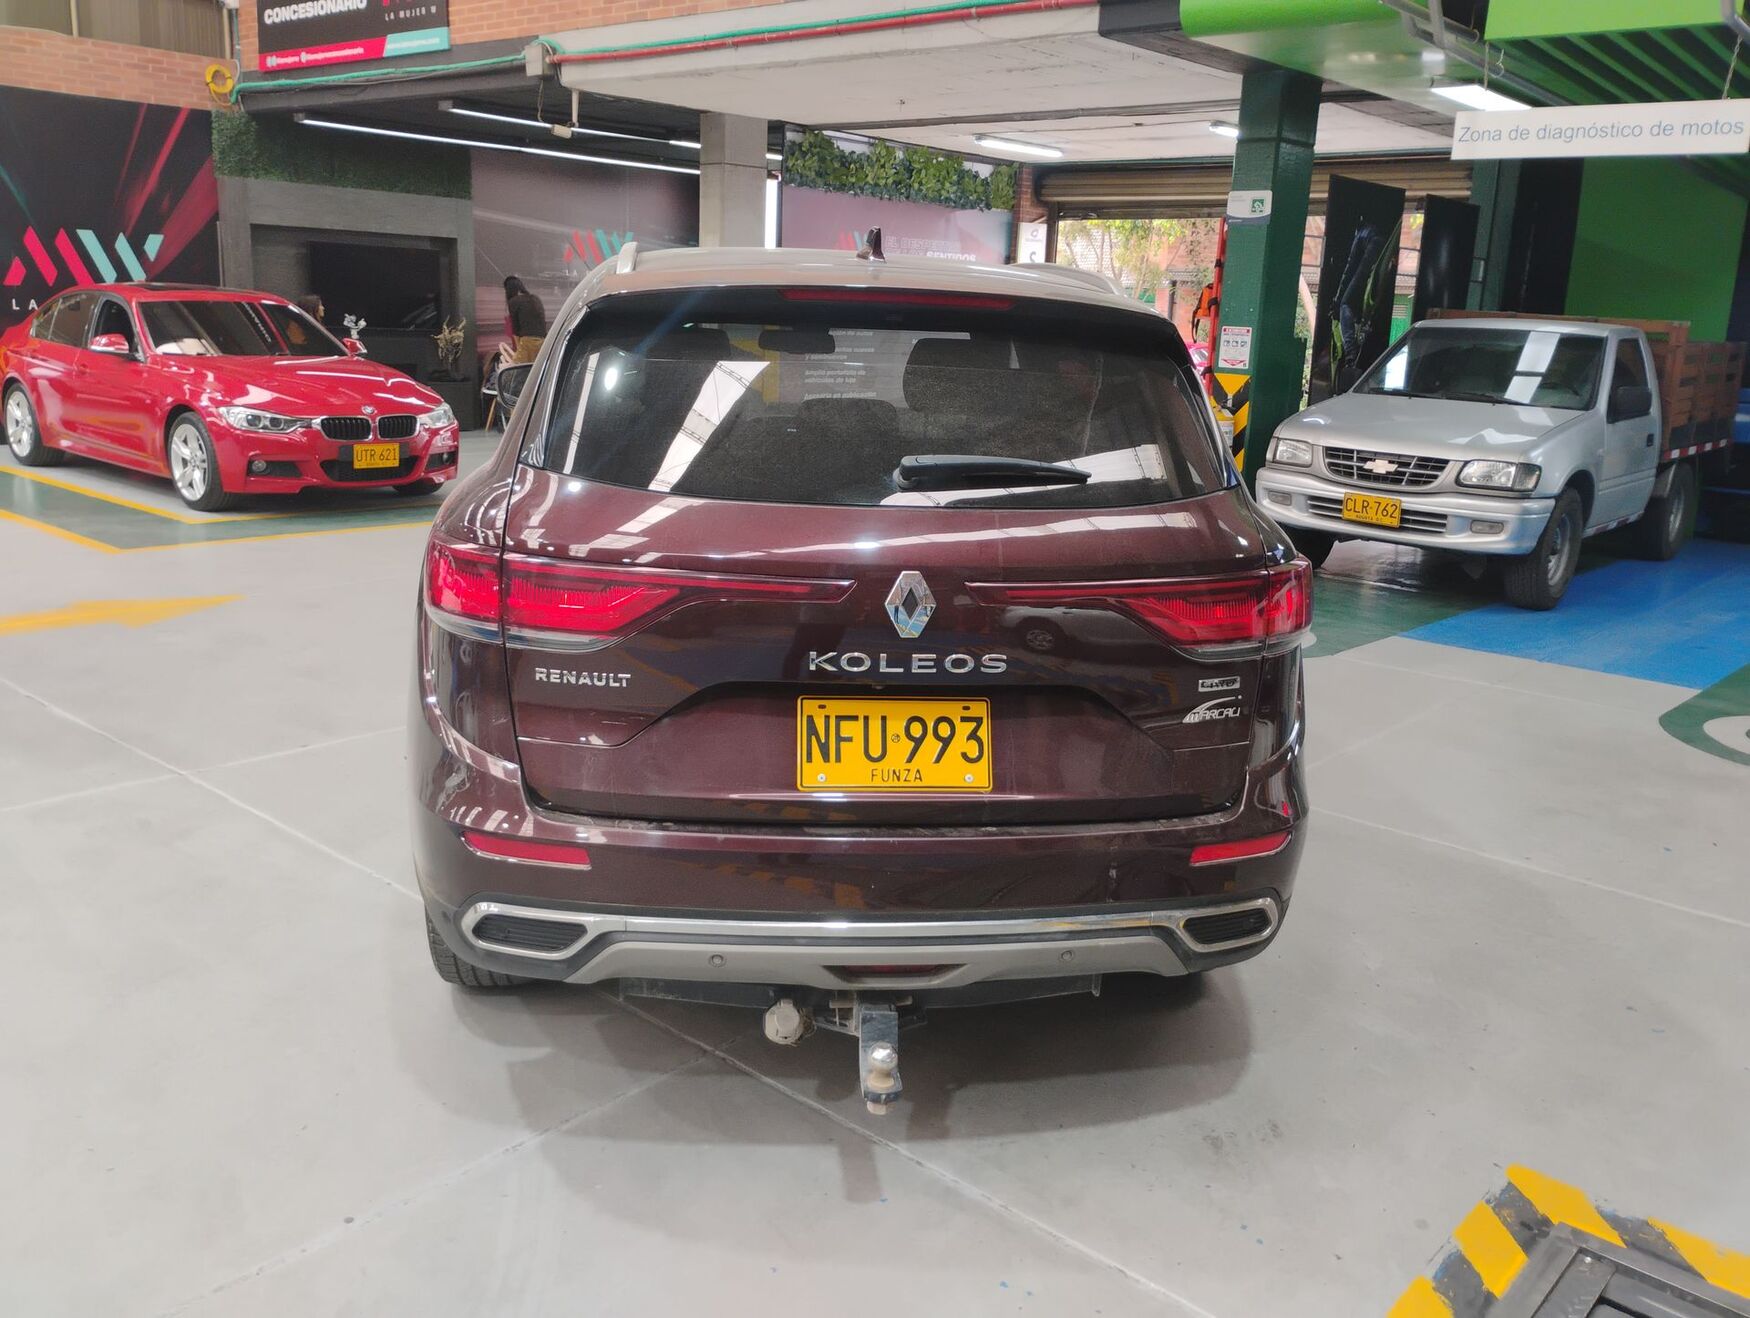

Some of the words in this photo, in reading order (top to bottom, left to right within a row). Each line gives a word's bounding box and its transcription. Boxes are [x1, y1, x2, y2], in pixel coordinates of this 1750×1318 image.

[264, 0, 368, 24] CONCESIONARIO
[1458, 126, 1501, 143] Zona
[1508, 125, 1530, 141] de
[1536, 121, 1643, 143] diagnóstico
[1650, 120, 1674, 137] de
[1681, 119, 1744, 136] motos
[356, 449, 376, 462] UTR
[379, 448, 397, 461] 621
[809, 651, 1007, 674] KOLEOS
[535, 667, 631, 687] RENAULT
[806, 715, 888, 764] NFU
[903, 715, 985, 764] 993
[871, 768, 923, 783] FUNZA
